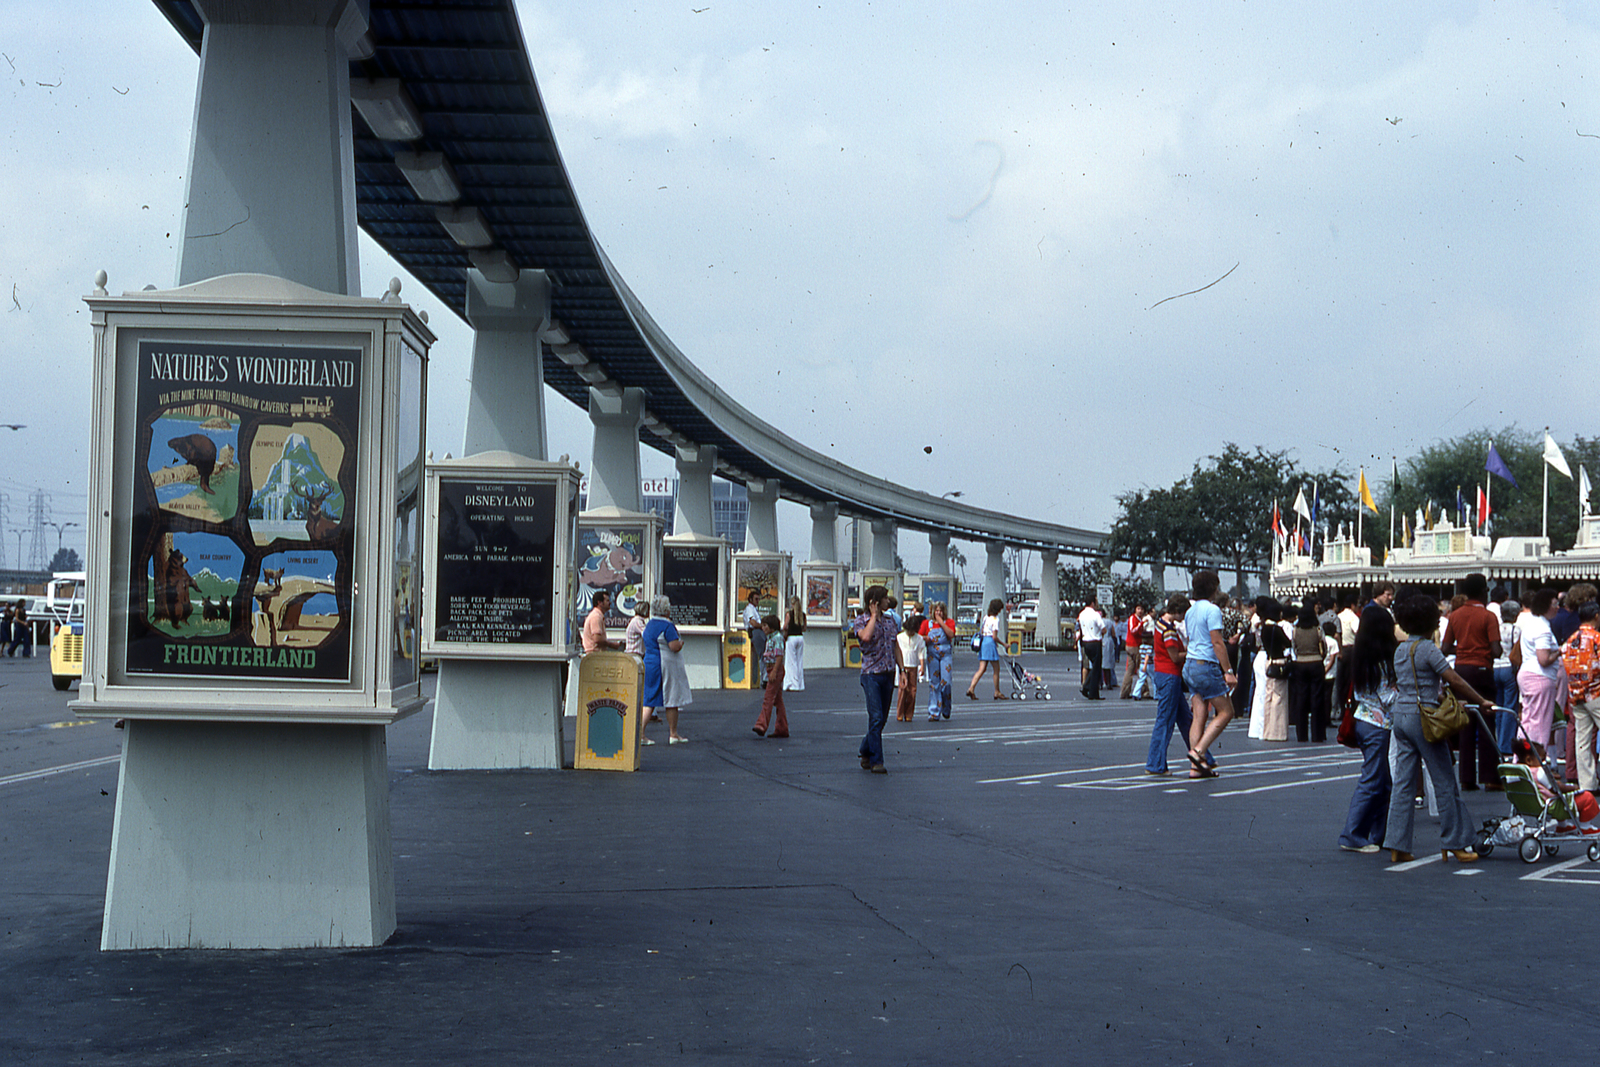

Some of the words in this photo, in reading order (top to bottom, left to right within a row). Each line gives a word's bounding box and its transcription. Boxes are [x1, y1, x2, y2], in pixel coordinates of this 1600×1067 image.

[150, 352, 229, 382] NATURE'S
[236, 356, 354, 388] WONDERLAND
[159, 394, 169, 405] VIA
[171, 390, 180, 403] THE
[181, 389, 195, 401] MINE
[197, 388, 214, 400] TRAIN
[215, 389, 230, 402] THRU
[231, 392, 260, 410] RAINBOW
[260, 400, 289, 414] CAVERNS
[465, 495, 535, 507] DISNEYLAND
[600, 531, 622, 547] DUMBO
[164, 644, 316, 669] FRONTIERLAND
[594, 667, 623, 678] PUSH
